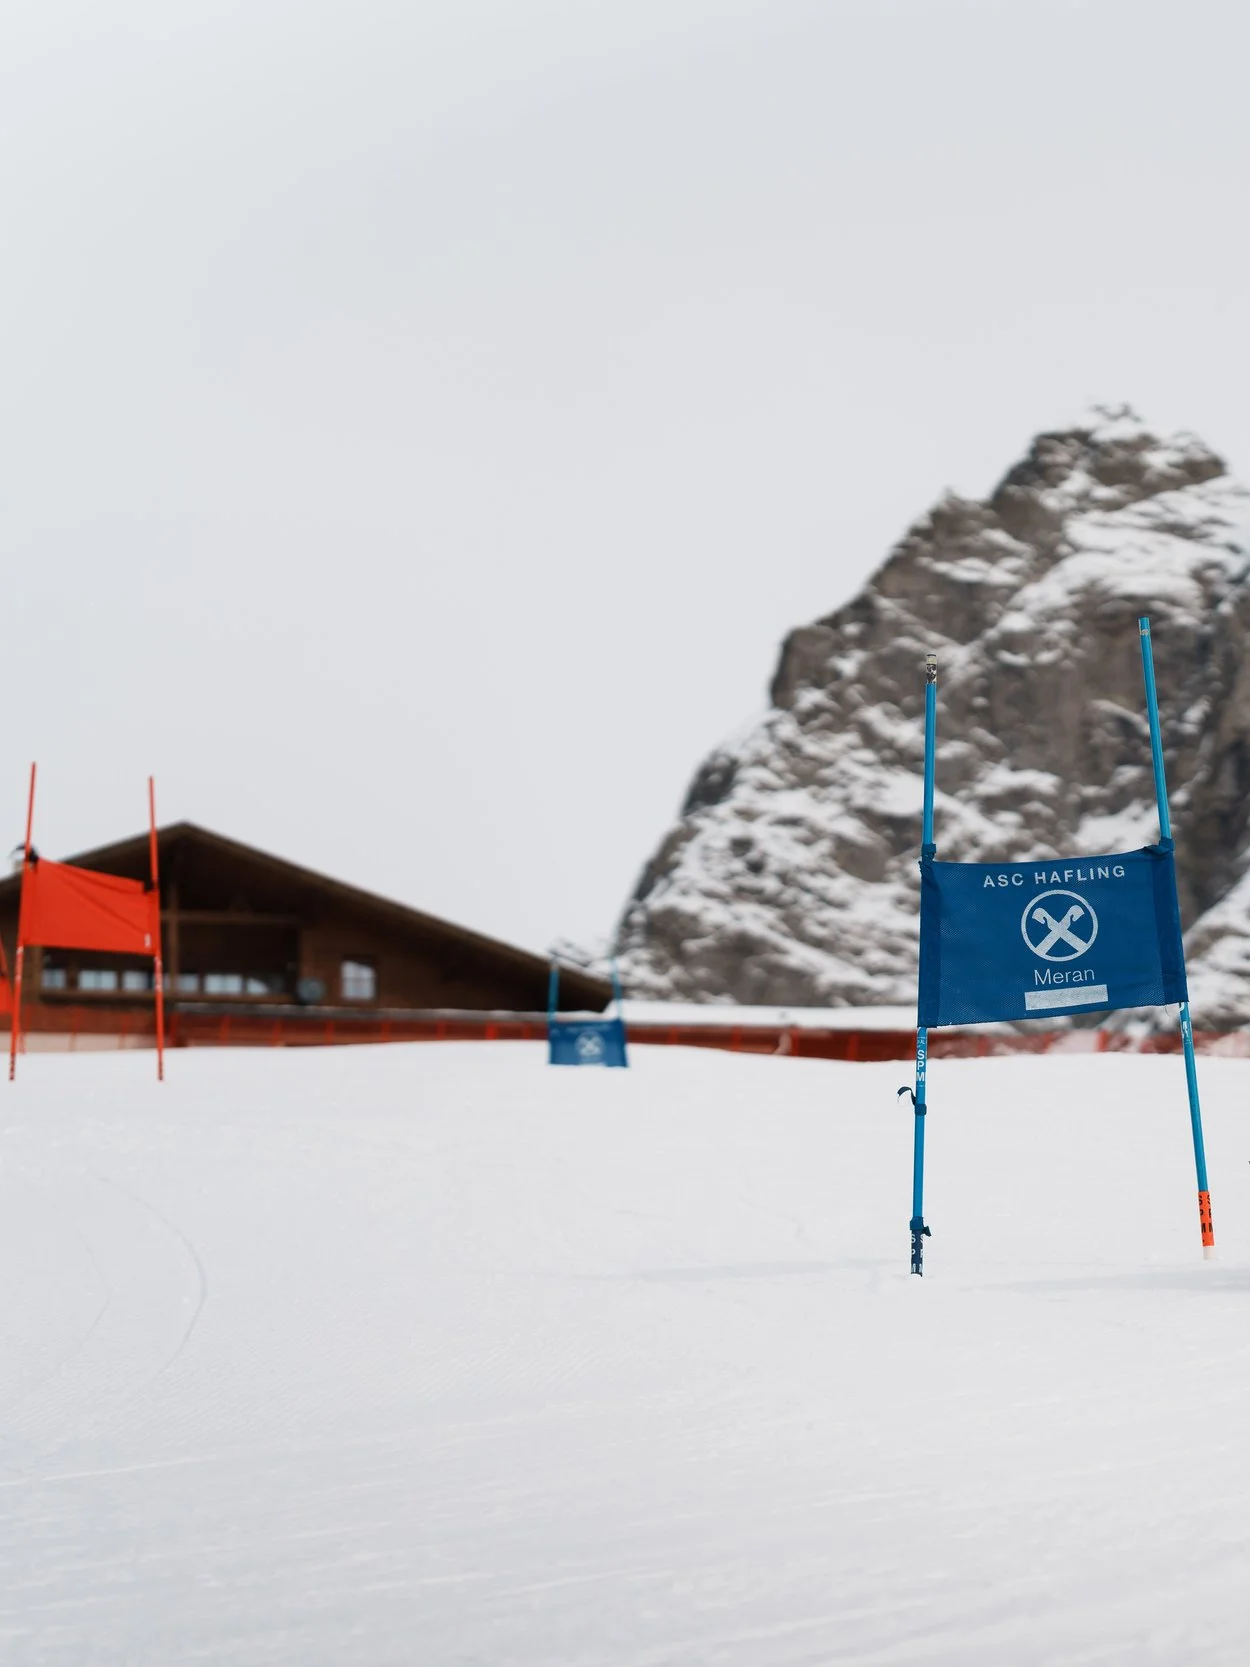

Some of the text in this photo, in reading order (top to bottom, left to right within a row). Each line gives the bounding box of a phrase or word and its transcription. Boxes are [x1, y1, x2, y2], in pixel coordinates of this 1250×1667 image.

[983, 865, 1125, 888] ASC HAFLING
[1034, 968, 1095, 986] Meran
[916, 1049, 925, 1082] SPM
